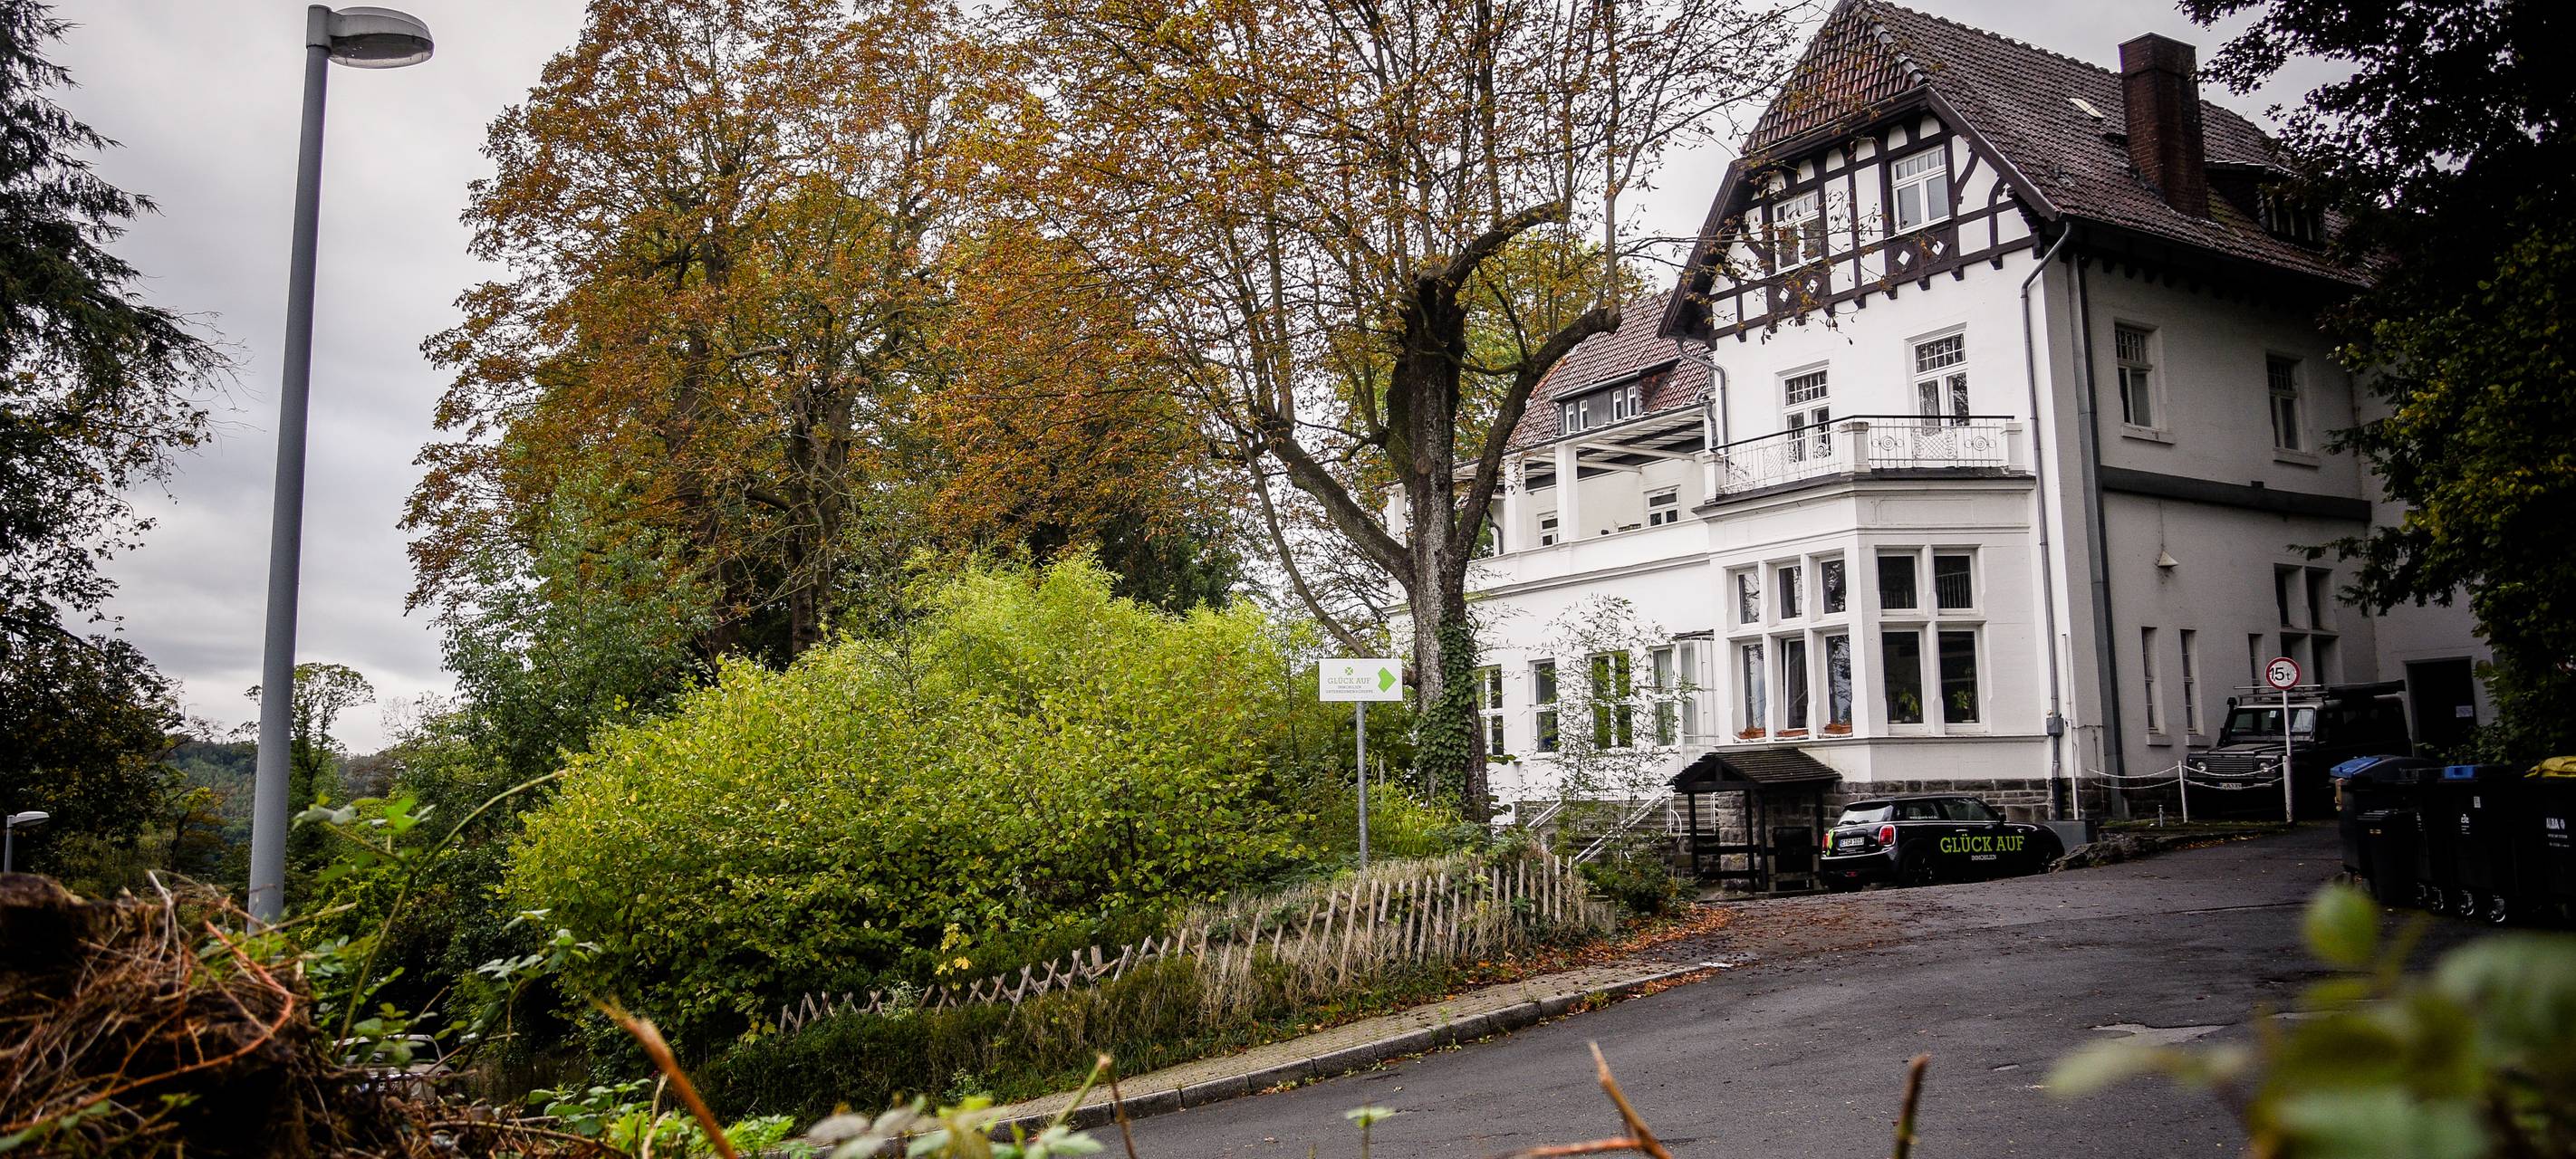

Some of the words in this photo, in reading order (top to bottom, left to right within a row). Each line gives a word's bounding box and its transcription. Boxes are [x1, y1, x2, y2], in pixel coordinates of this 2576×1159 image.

[1328, 676, 1354, 685] GLÜCK
[1940, 834, 1993, 853] GLÜCK
[1996, 836, 2024, 851] AUF
